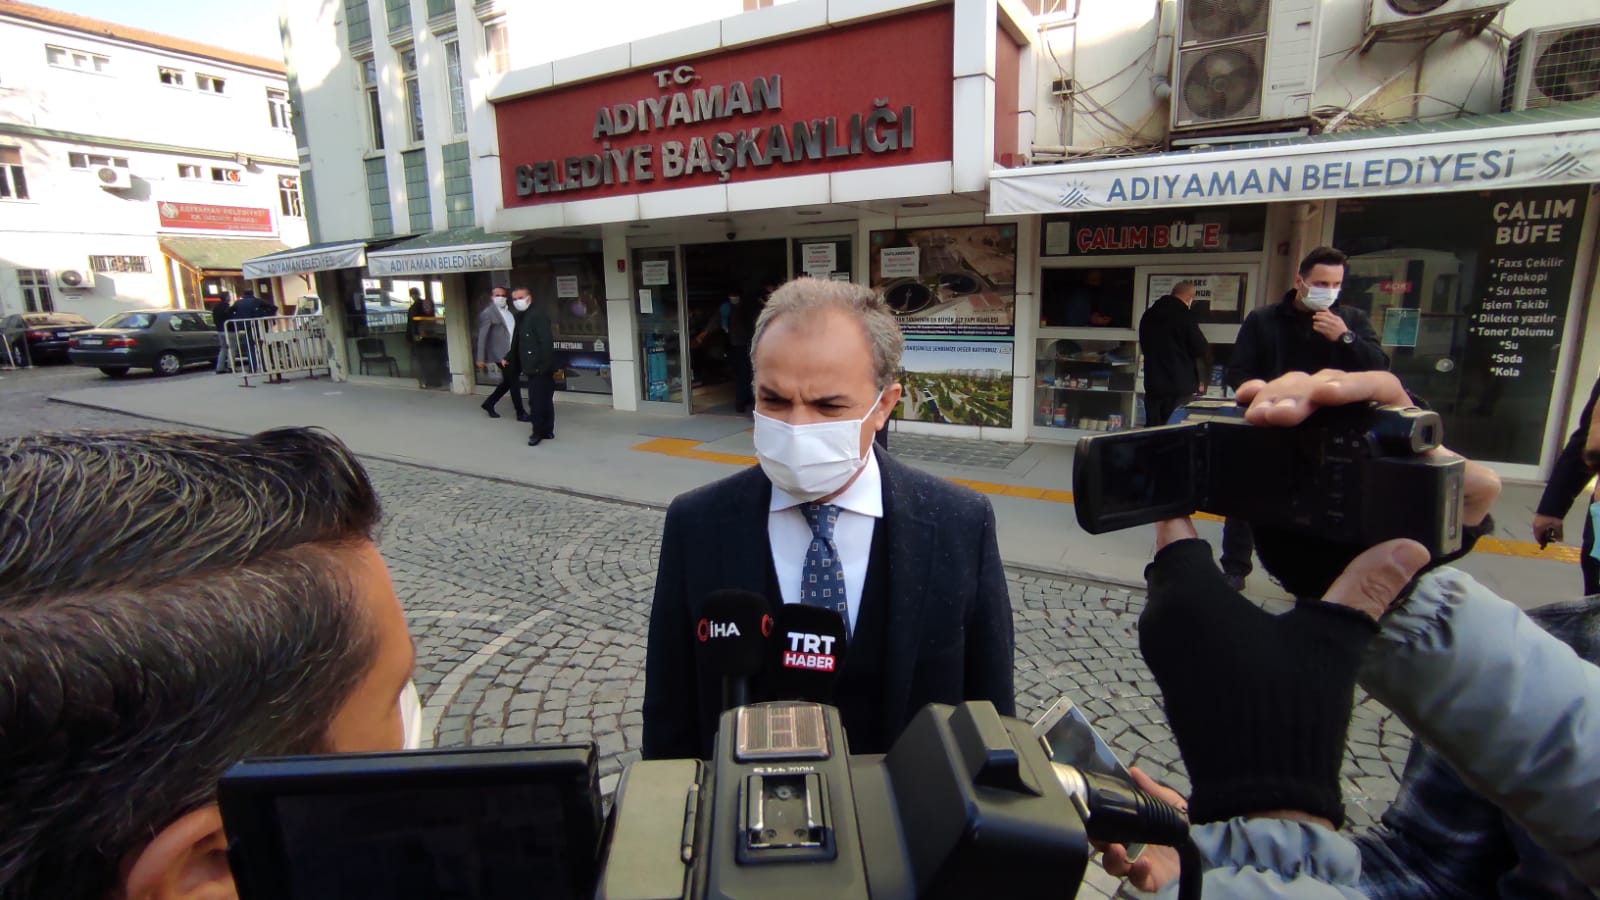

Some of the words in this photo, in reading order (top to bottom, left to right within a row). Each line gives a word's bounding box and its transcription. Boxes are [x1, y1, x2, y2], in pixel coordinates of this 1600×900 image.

[593, 74, 782, 139] ADIYAMAN
[515, 142, 654, 196] BELEDİYE
[662, 97, 914, 182] BAŞKANLIĞI
[1106, 166, 1292, 202] ADIYAMAN
[1492, 198, 1576, 224] ÇALIM
[1077, 226, 1148, 253] ÇALIM
[1153, 221, 1221, 248] BÜFE
[1495, 221, 1562, 245] BÜFE
[267, 259, 301, 274] ADIYAMAN
[390, 258, 436, 273] ADIYAMAN
[1497, 258, 1522, 268] Faxs
[1500, 272, 1548, 283] Fotokopi
[1496, 286, 1510, 296] Su
[1512, 286, 1547, 296] Abone
[1515, 299, 1549, 310] Takibi
[1477, 327, 1509, 337] Toner
[1511, 327, 1554, 337] Dolumu
[787, 631, 836, 655] TRT
[784, 653, 834, 670] HABER
